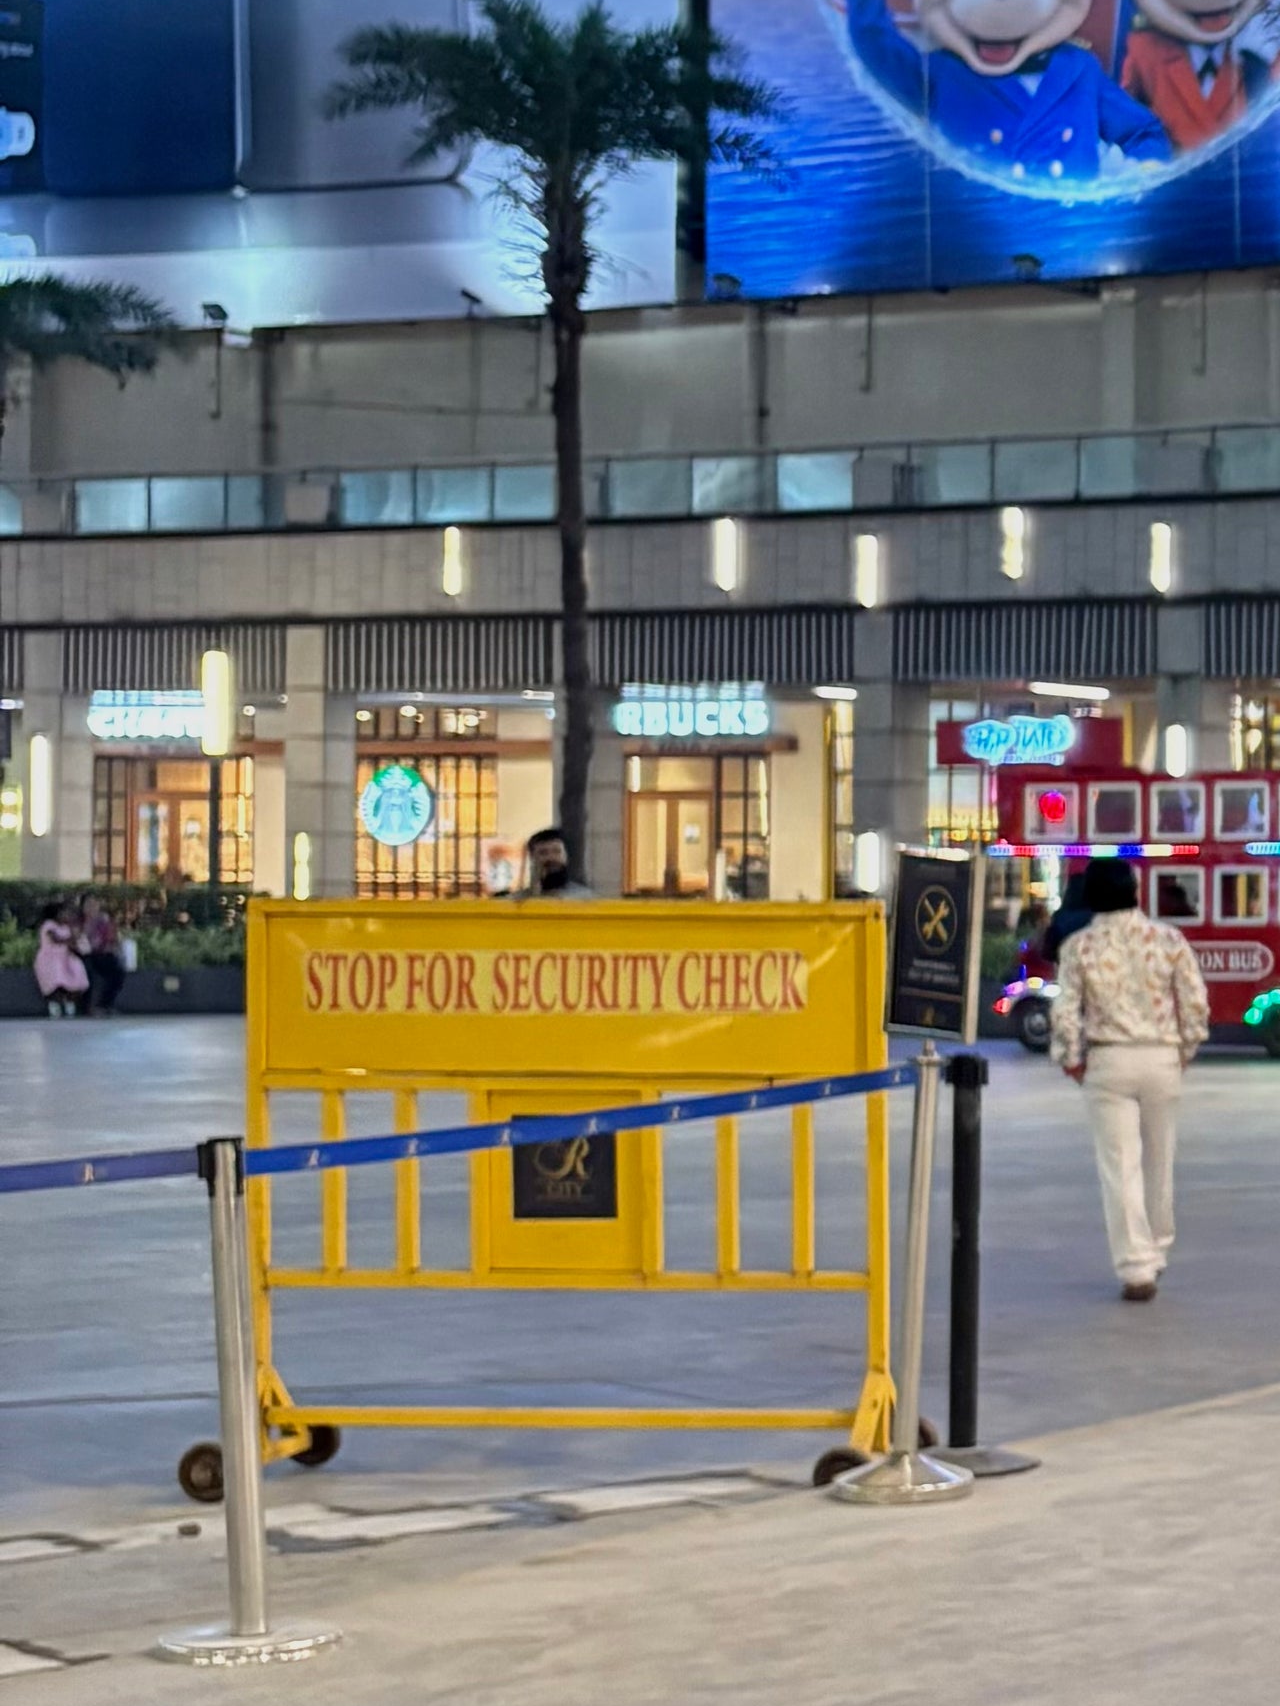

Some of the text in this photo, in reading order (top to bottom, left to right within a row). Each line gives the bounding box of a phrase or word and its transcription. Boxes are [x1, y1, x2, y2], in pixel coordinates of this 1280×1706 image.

[615, 699, 769, 736] RBUCKS
[306, 950, 806, 1011] STOP FOR SECURITY CHECK
